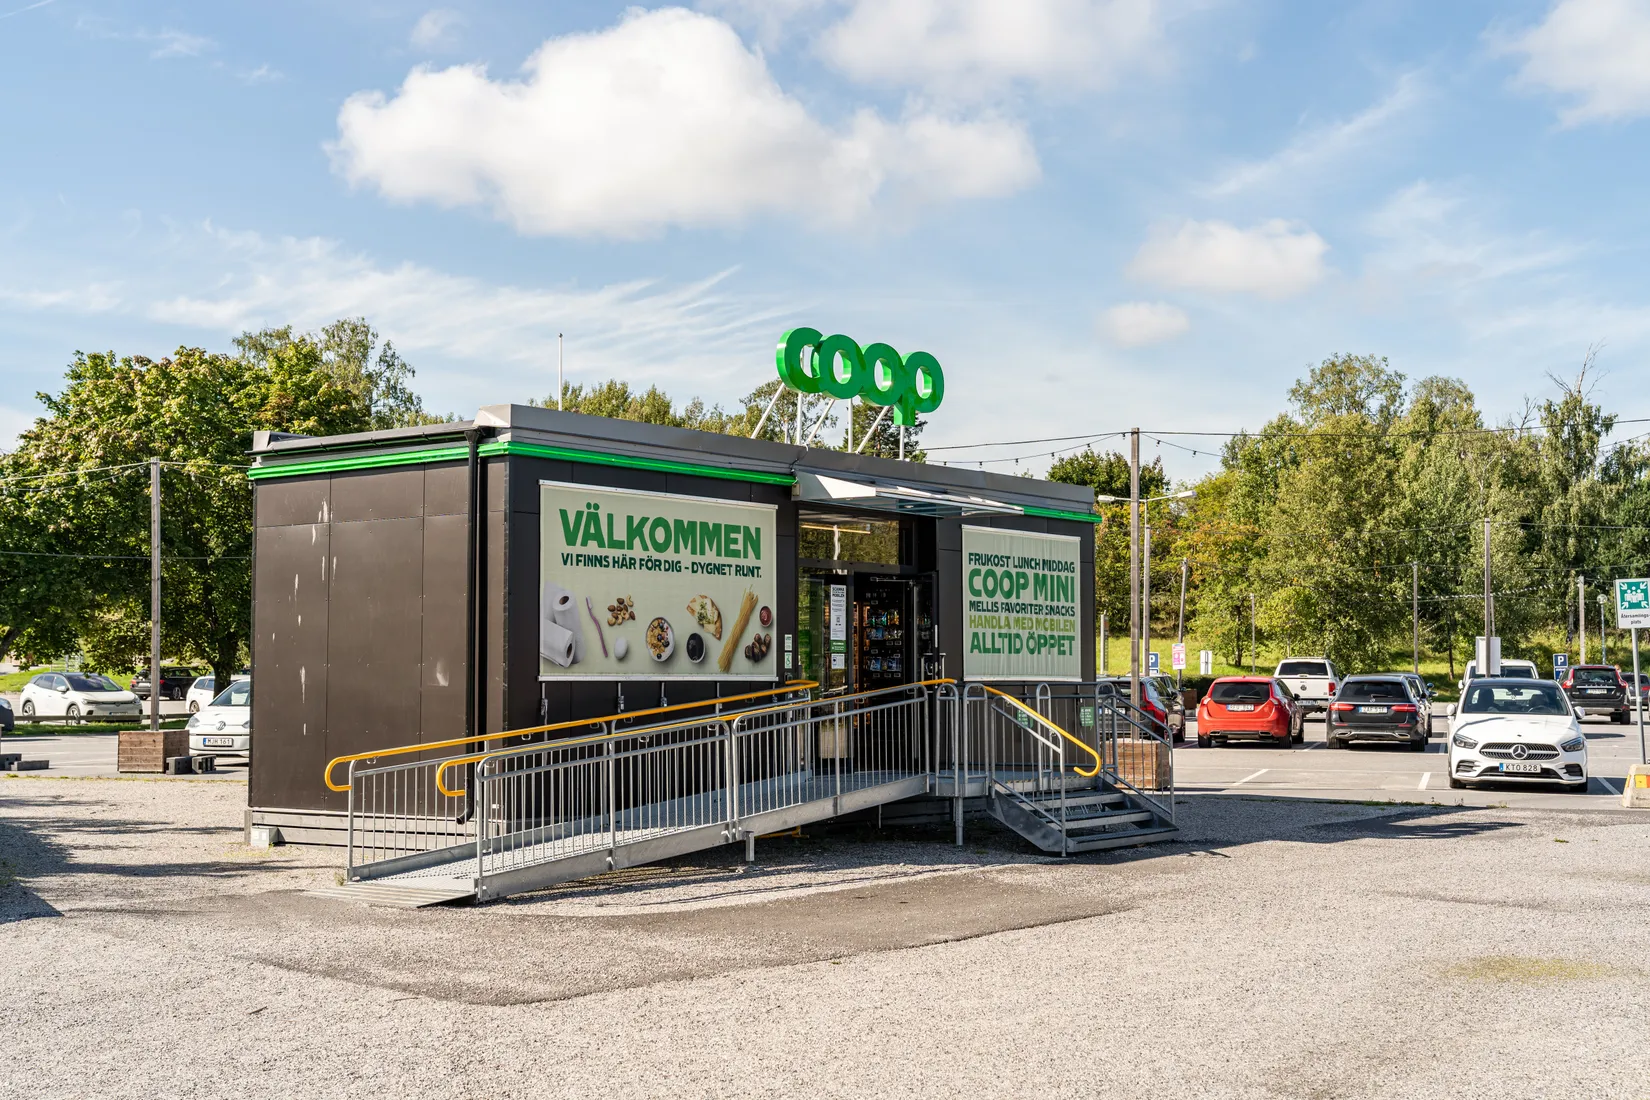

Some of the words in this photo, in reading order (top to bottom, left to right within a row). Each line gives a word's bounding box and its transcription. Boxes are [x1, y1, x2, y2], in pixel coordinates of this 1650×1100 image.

[776, 327, 945, 427] coop
[559, 501, 762, 560] VÄLKOMMEN
[561, 552, 574, 566] VI
[576, 554, 610, 568] FINNS
[612, 554, 637, 570] HÄR
[639, 555, 662, 572] FÖR
[663, 560, 682, 573] DIG
[691, 563, 733, 576] DYGNET
[735, 565, 762, 578] RUNT.
[968, 552, 1011, 568] FRUKOST
[1013, 556, 1041, 570] LUNCH
[1042, 559, 1075, 573] MIDDAG
[968, 568, 1029, 600] COOP
[1033, 572, 1075, 603] MINI
[969, 600, 999, 613] MELLIS
[1000, 602, 1044, 615] FAVORITER
[1044, 604, 1075, 617] SNACKS
[969, 614, 1011, 630] HANDLA
[1013, 616, 1033, 630] MED
[1035, 617, 1075, 632] MOBILEN
[970, 631, 1023, 654] ALLTID
[1026, 631, 1075, 656] ÖPPET
[1557, 656, 1564, 665] P
